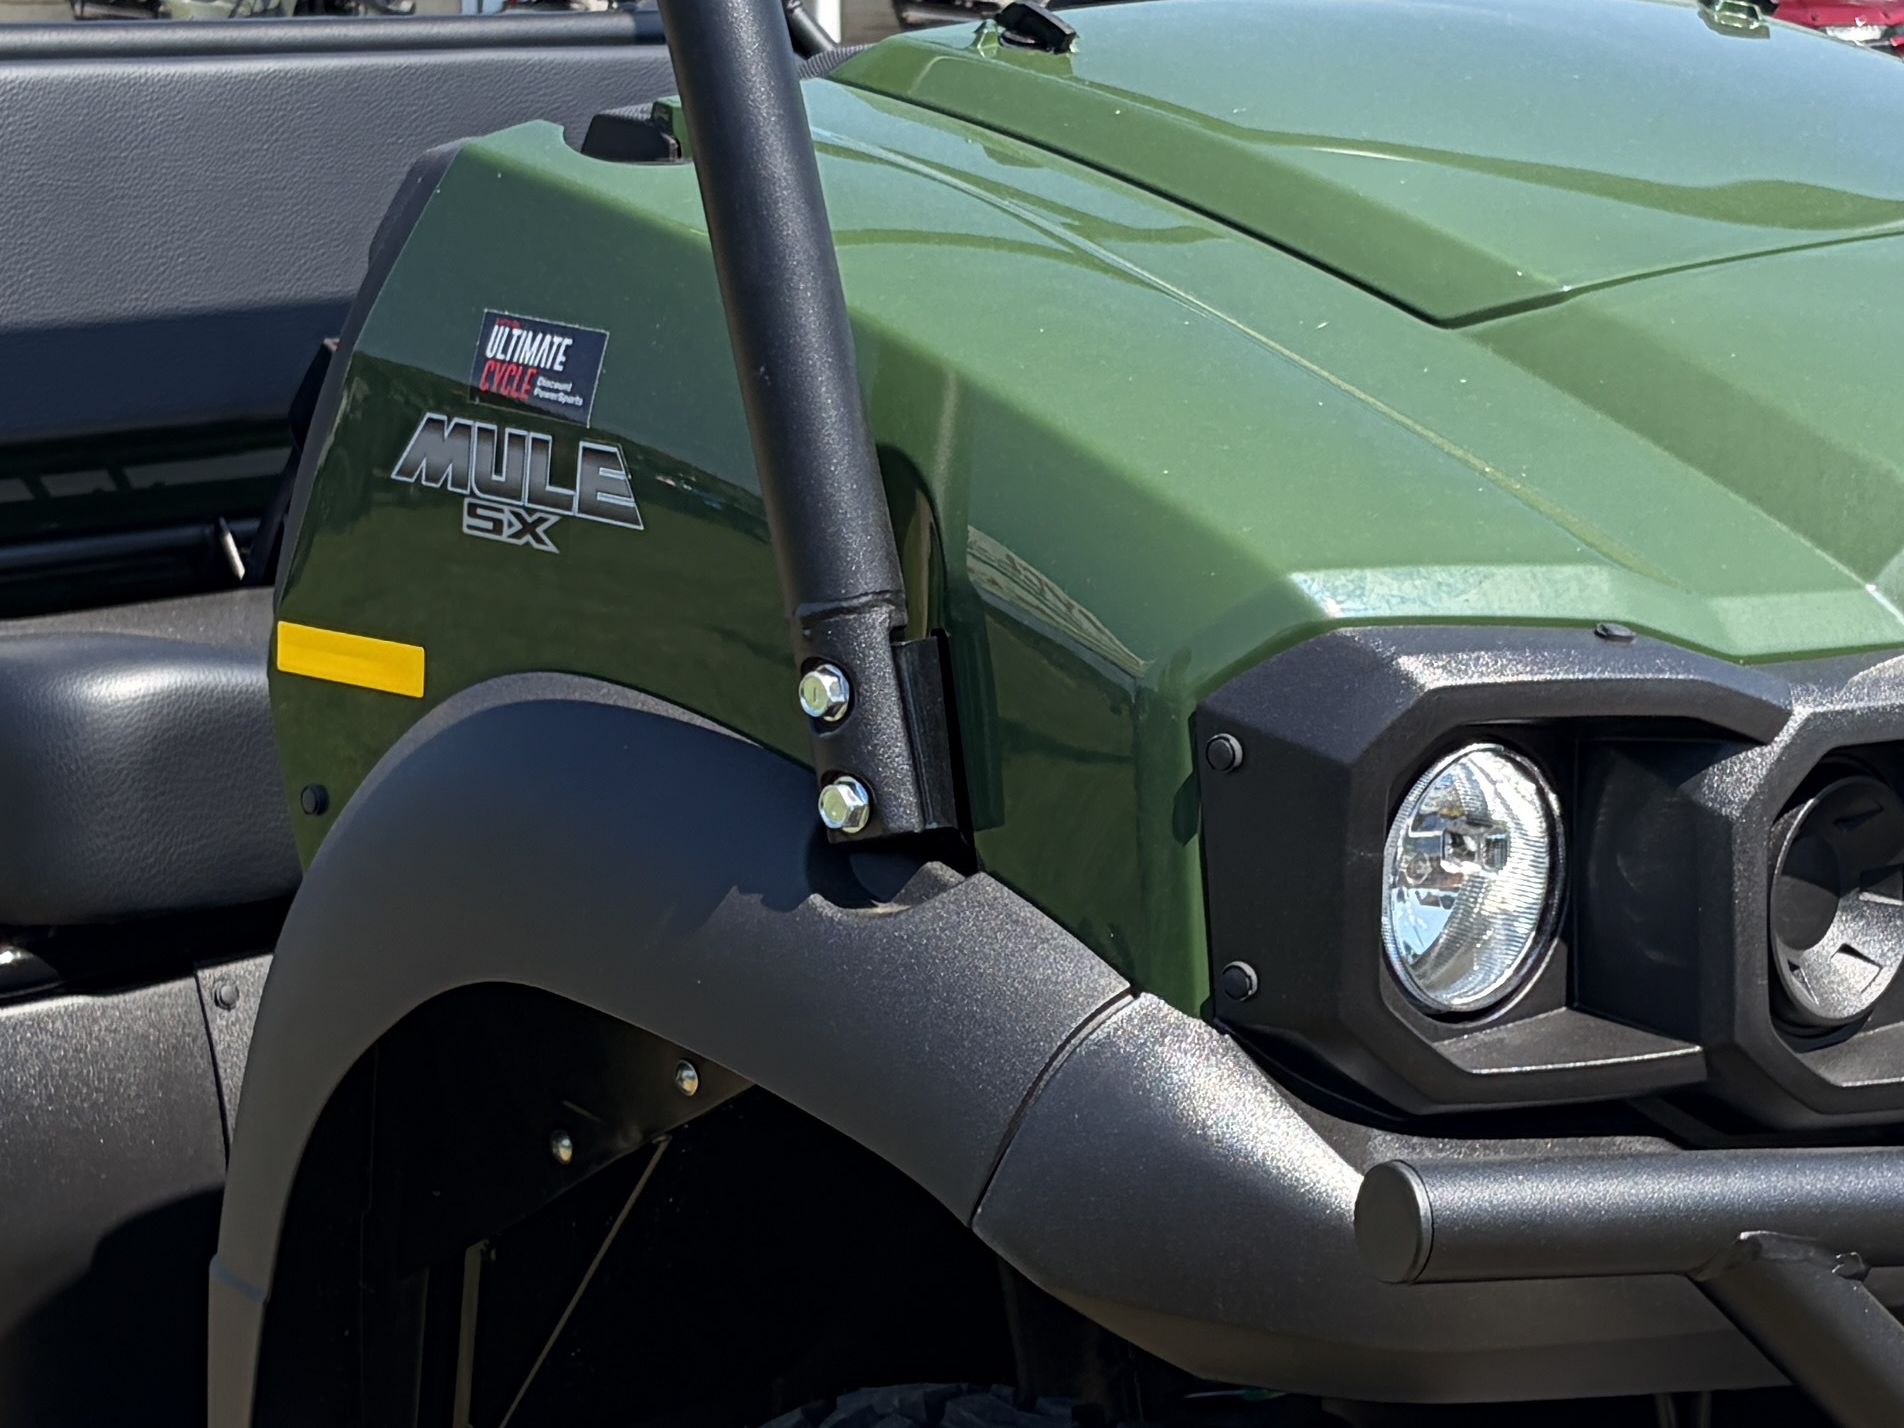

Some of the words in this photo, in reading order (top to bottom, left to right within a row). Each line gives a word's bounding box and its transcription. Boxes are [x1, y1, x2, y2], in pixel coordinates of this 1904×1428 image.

[485, 324, 573, 372] ULTIMATE
[479, 359, 539, 401] CYCLE
[390, 411, 645, 531] MULE
[462, 497, 561, 554] SX
